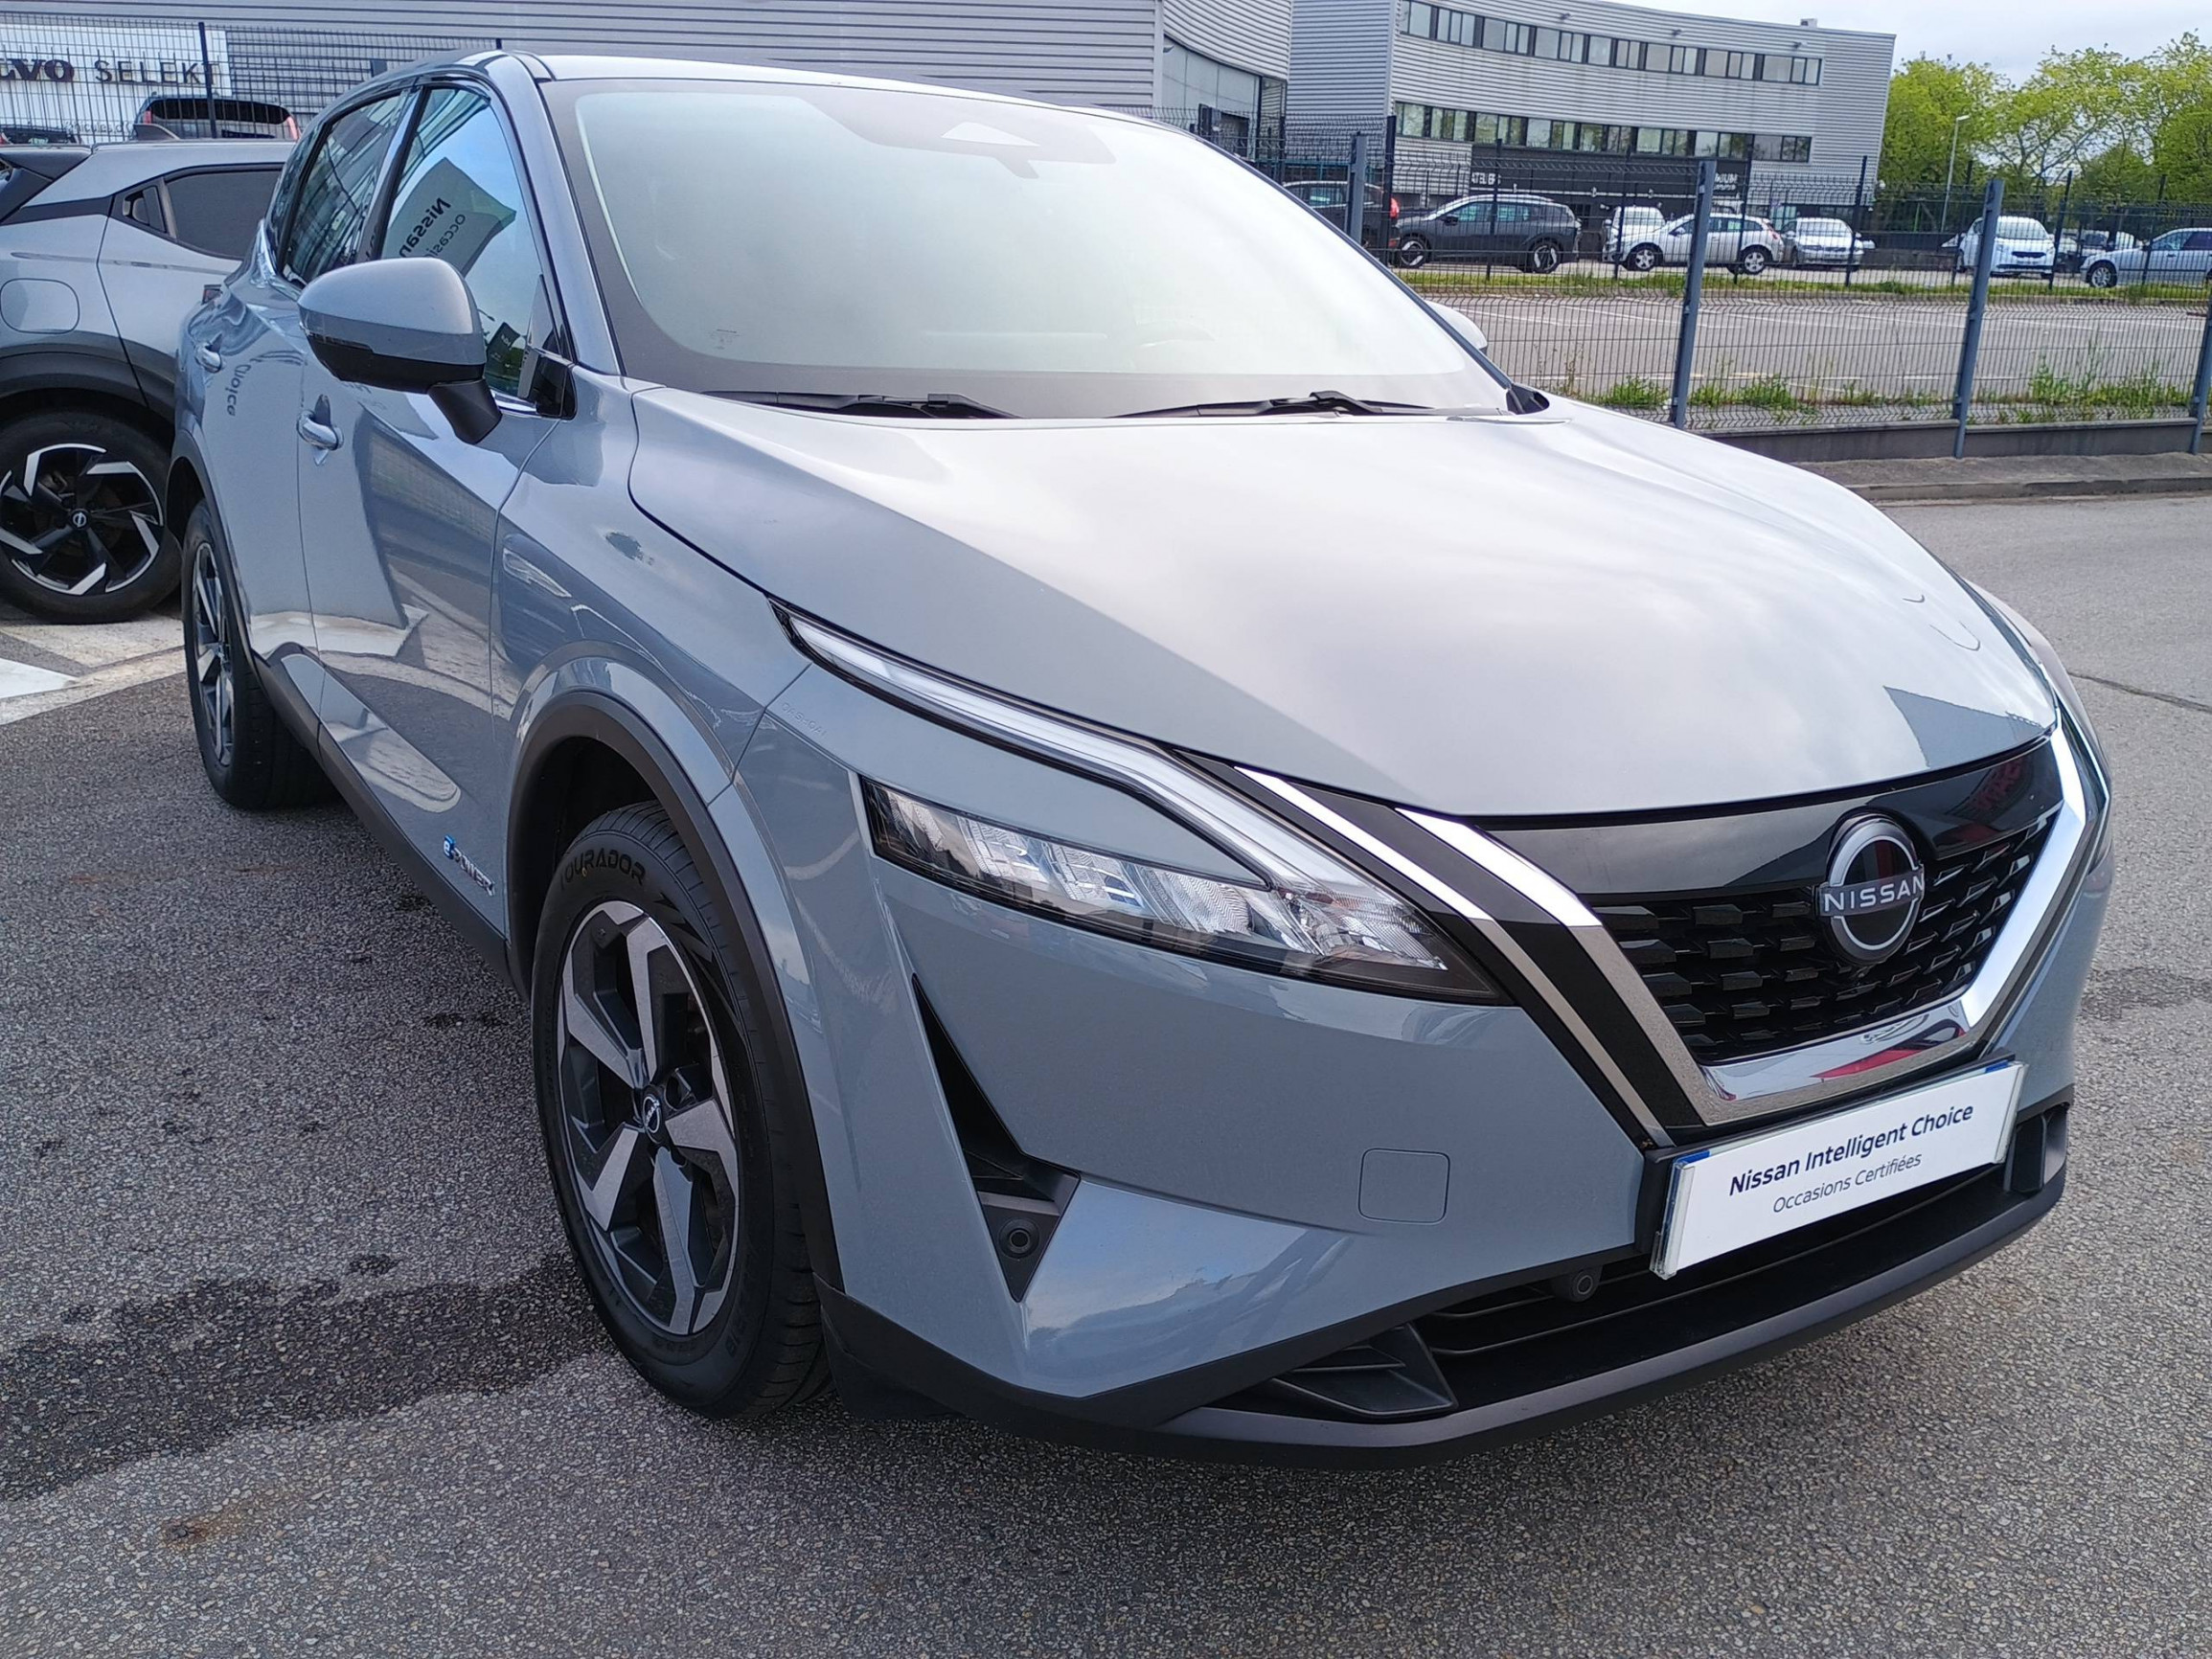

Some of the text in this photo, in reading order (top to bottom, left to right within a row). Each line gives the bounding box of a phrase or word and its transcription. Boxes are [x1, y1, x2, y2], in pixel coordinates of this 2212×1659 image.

[94, 59, 219, 84] SELEKT
[1824, 872, 1924, 912] NISSAN
[1728, 1105, 1973, 1196] Nissan Intelligent Choice
[1772, 1153, 1922, 1213] Occasions Certifiées
